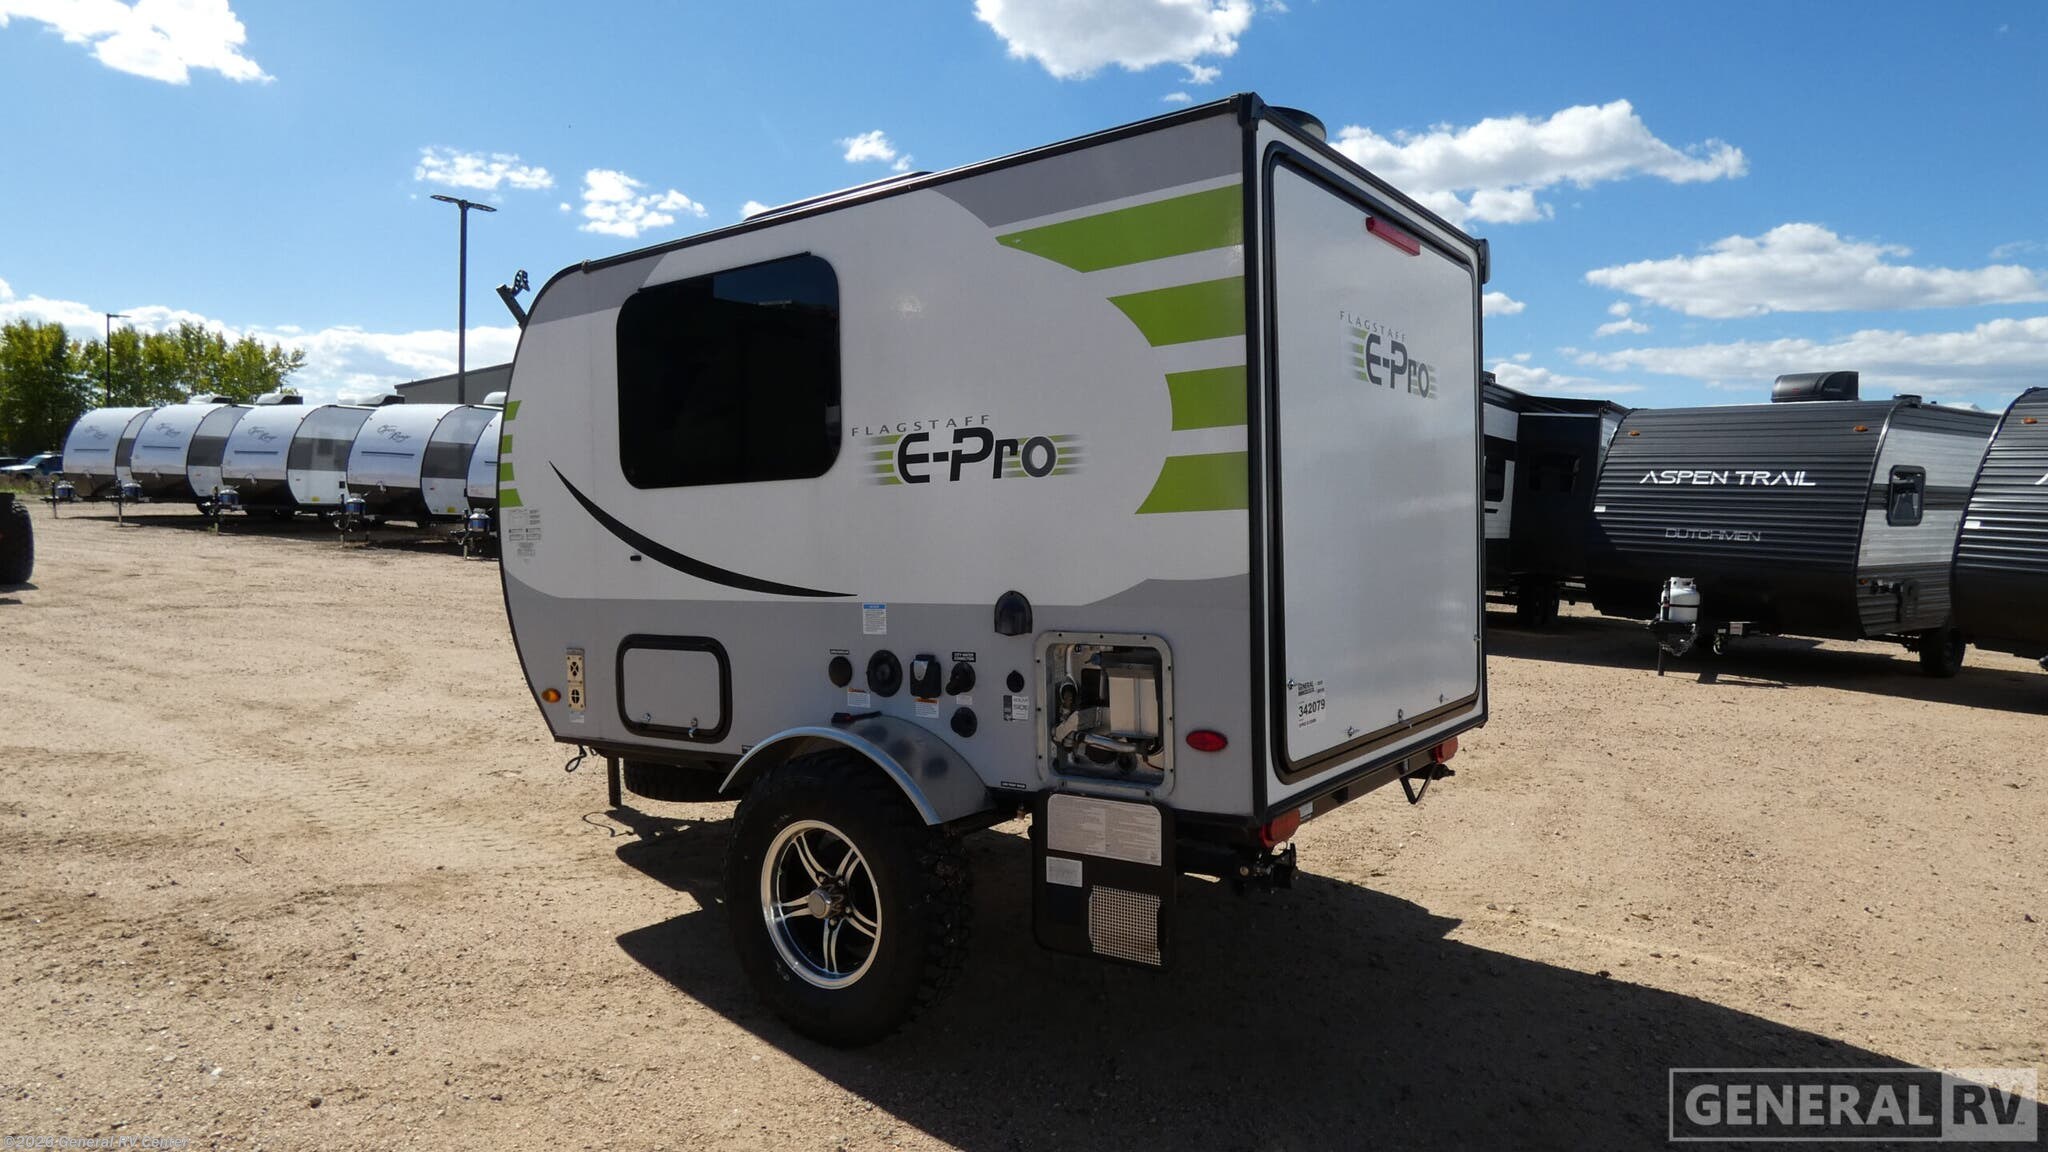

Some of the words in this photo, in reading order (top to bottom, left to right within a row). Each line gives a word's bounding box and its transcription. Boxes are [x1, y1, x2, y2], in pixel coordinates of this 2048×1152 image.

[1339, 310, 1407, 342] FLAGSTAFF
[1365, 332, 1430, 399] E-Pro
[851, 414, 991, 437] FLAGSTAFF
[896, 426, 1057, 484] E-Pro
[1639, 470, 1729, 485] ASPEN
[1735, 470, 1817, 487] TRAIL
[1664, 527, 1762, 542] DUTCHMEN
[1298, 699, 1326, 717] 342079
